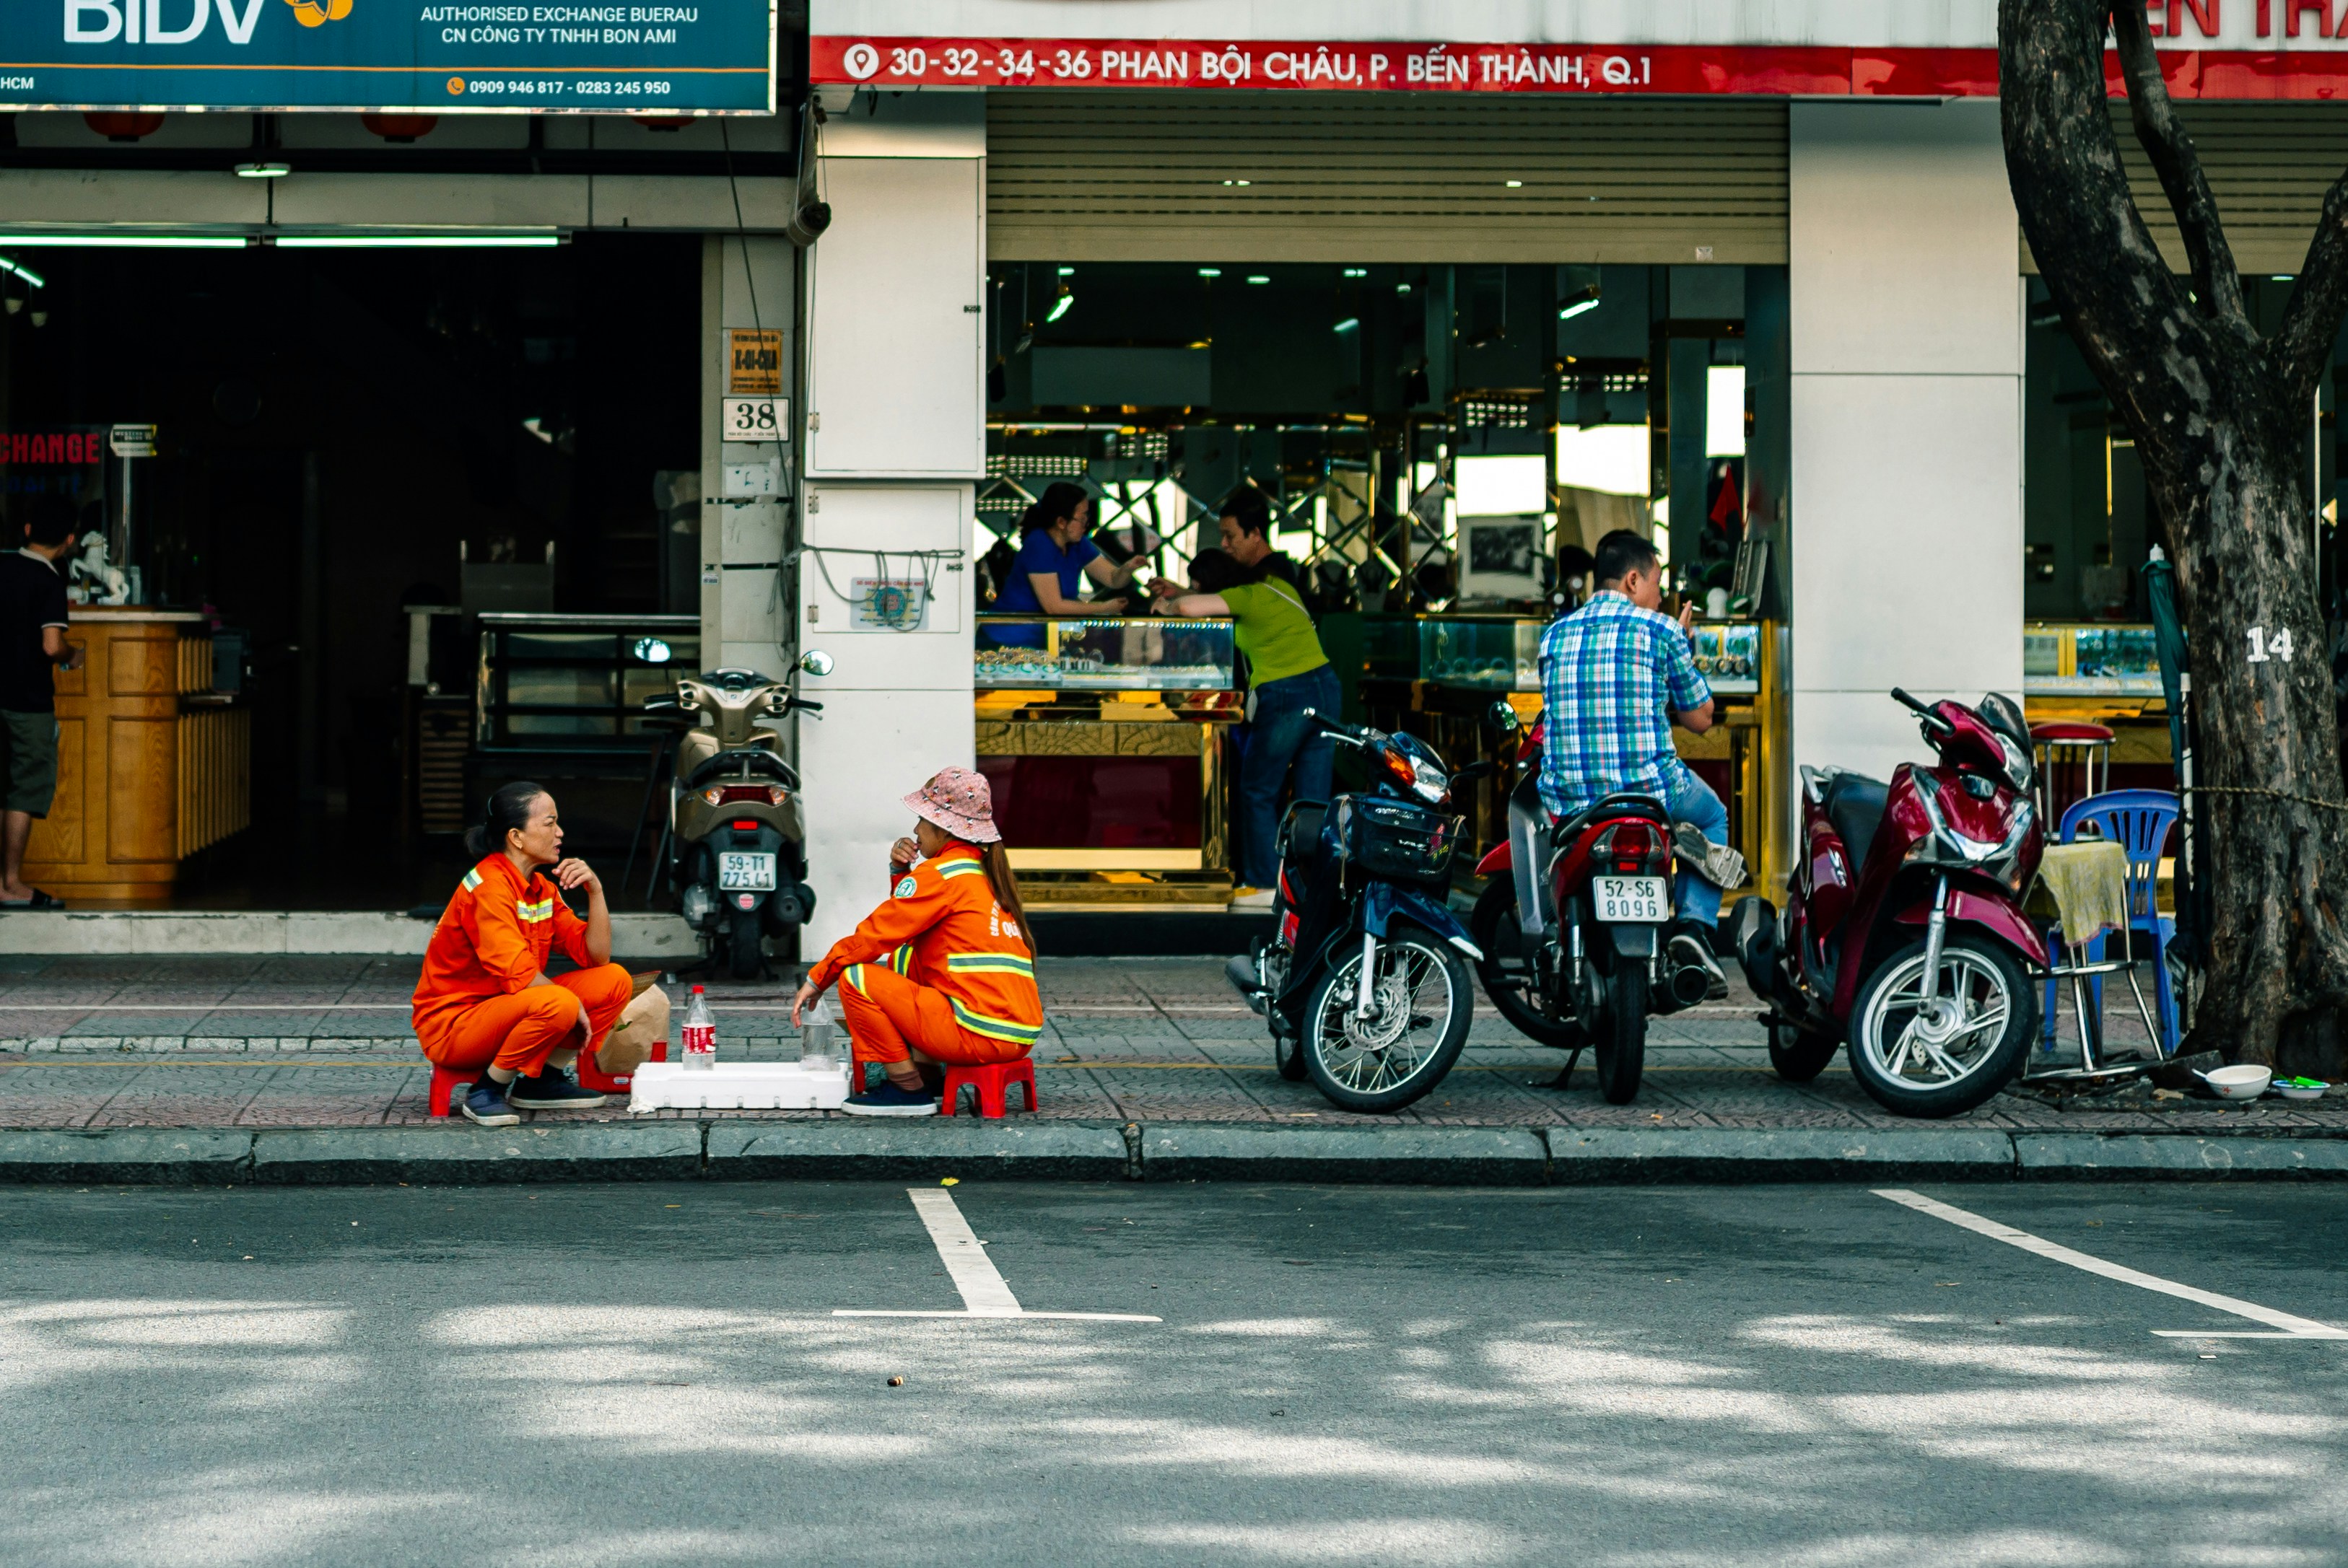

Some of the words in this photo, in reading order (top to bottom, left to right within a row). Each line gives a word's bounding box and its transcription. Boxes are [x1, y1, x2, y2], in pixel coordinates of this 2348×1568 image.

[64, 0, 264, 44] BIDV
[421, 6, 528, 22] AUTHORISED
[533, 7, 626, 22] EXCHANGE
[630, 7, 698, 22] BUERAU
[442, 28, 466, 43] CN
[471, 25, 520, 43] CÔNG
[523, 28, 546, 43] TY
[549, 29, 598, 43] TNHH
[603, 29, 640, 43] BON
[643, 29, 676, 43] AMI
[1101, 51, 1188, 79] PHAN
[1201, 45, 1251, 85] BỘI
[1264, 45, 1363, 85] CHÂU,
[1371, 53, 1396, 82] P.
[1408, 43, 1469, 83] BẾN
[1480, 48, 1591, 89] THÀNH,
[1602, 56, 1651, 85] Q.1
[0, 76, 34, 89] HCM
[469, 81, 504, 94] 0909
[507, 81, 533, 94] 946
[537, 81, 563, 94] 817
[576, 82, 611, 94] 0283
[615, 82, 641, 94] 245
[645, 82, 670, 94] 950
[736, 403, 776, 430] 38
[2247, 626, 2295, 662] 14
[728, 856, 765, 871] 59-T1
[1605, 880, 1655, 898] 52-S6
[1607, 899, 1658, 918] 8096
